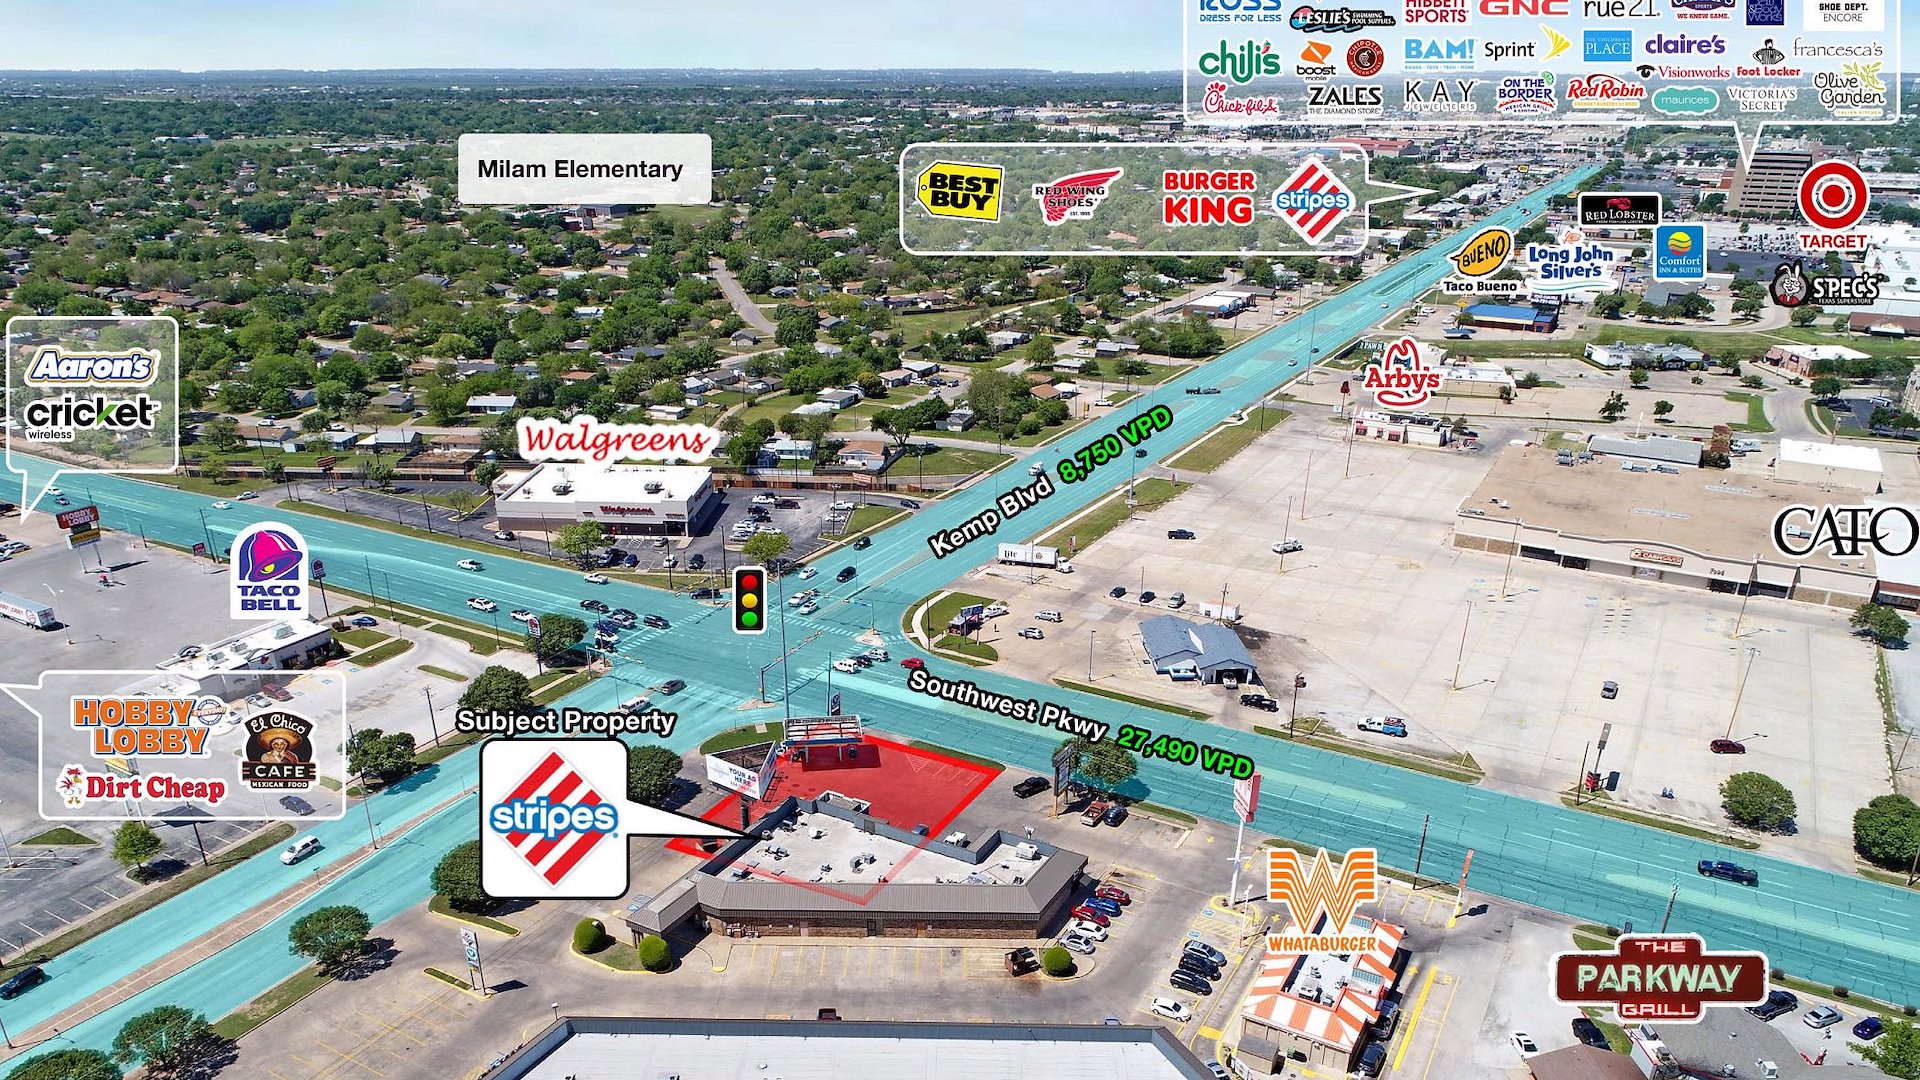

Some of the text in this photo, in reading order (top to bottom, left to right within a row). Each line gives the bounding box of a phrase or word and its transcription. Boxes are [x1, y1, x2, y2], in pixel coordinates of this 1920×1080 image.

[62, 509, 91, 521] HOBBY
[69, 513, 95, 526] LOBBY
[729, 767, 746, 778] YOUR
